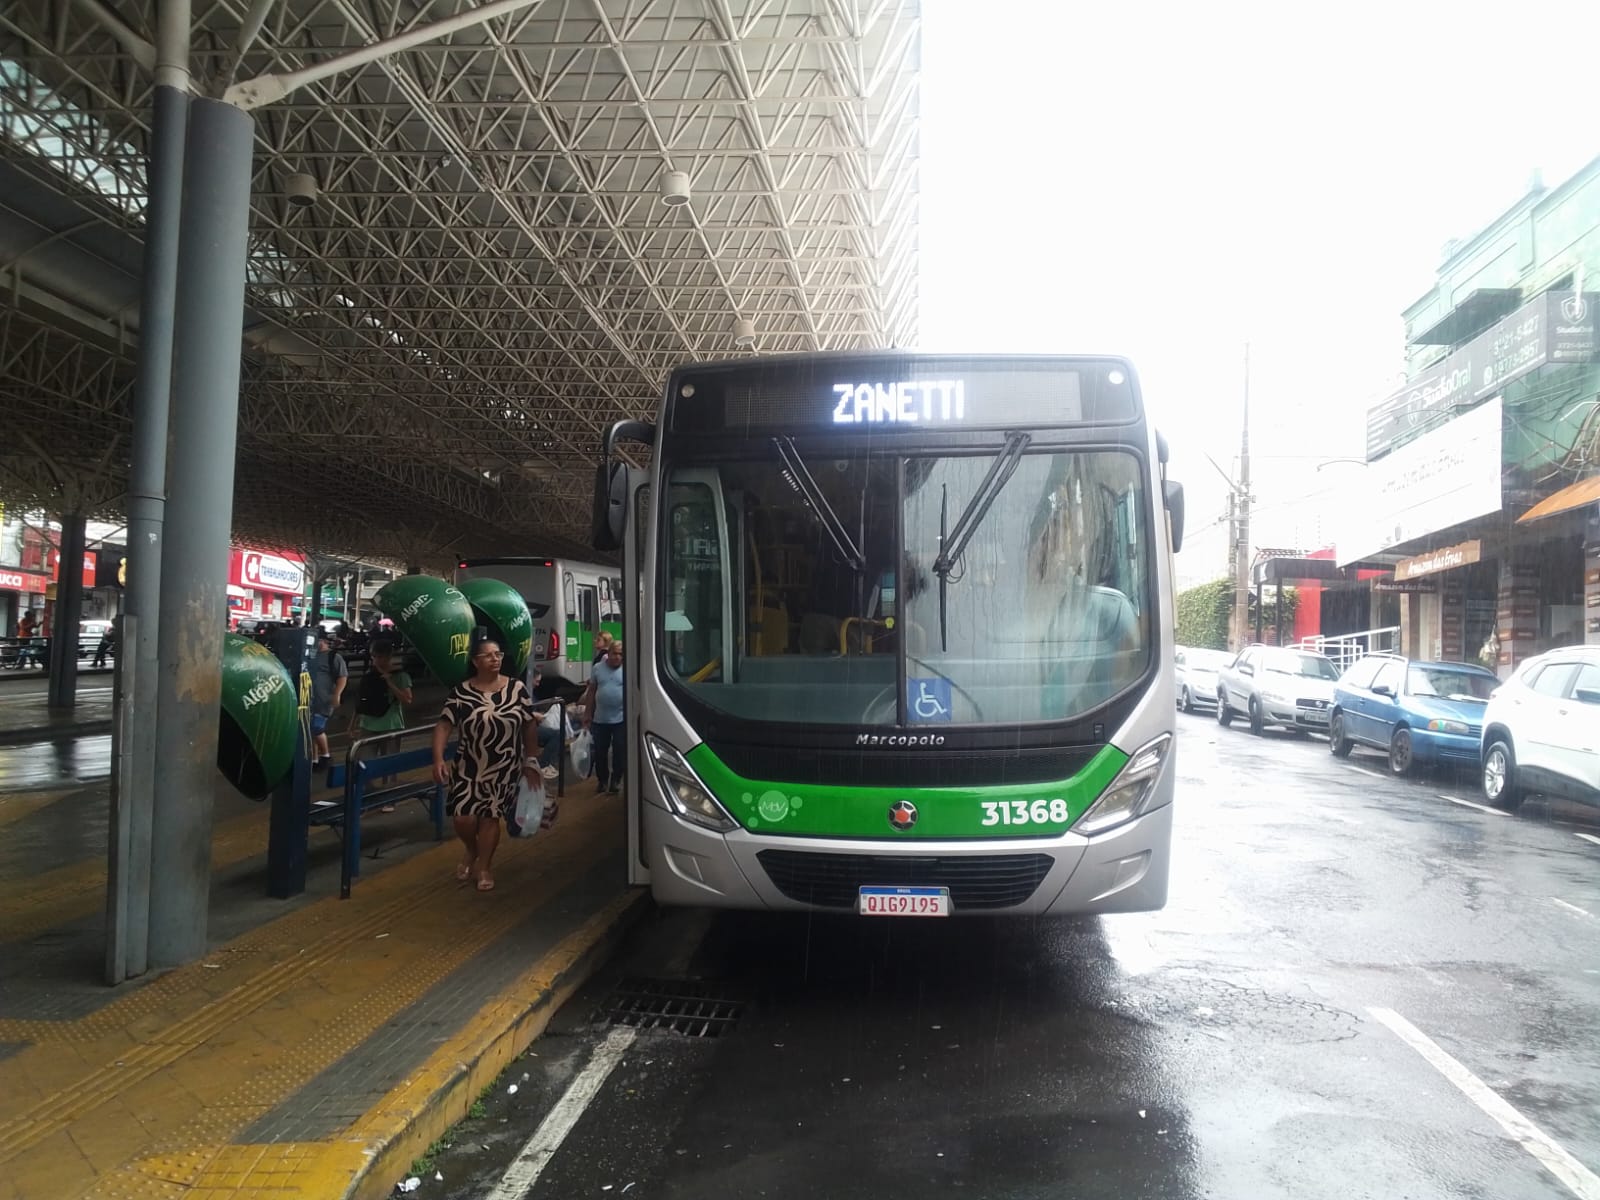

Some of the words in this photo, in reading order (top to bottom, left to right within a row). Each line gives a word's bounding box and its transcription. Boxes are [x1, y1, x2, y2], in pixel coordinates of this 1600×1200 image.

[833, 380, 965, 423] ZANETTI
[400, 593, 429, 622] Algar
[241, 674, 281, 711] Algar
[855, 733, 945, 747] Marcopolo
[981, 799, 1069, 826] 31368
